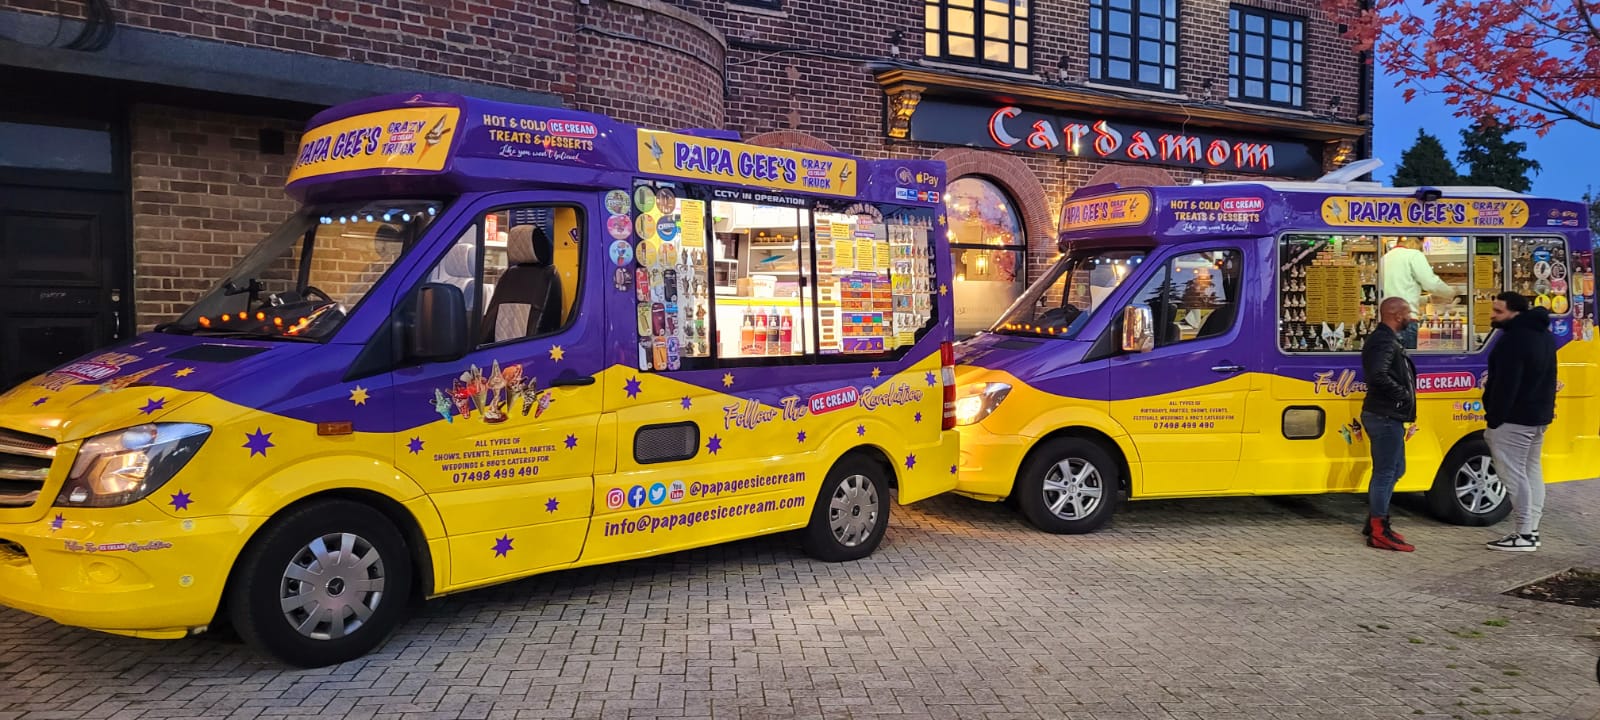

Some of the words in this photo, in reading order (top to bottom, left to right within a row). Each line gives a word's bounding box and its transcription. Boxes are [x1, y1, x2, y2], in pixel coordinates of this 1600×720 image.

[387, 121, 426, 134] CRAZY
[483, 114, 507, 128] HOT
[509, 117, 518, 129] &
[520, 118, 547, 132] COLD
[550, 122, 563, 133] ICE
[564, 123, 595, 135] CREAM
[489, 129, 532, 145] TREATS
[533, 134, 542, 146] &
[543, 135, 593, 151] DESSERTS
[987, 105, 1276, 172] Cardamom
[296, 135, 333, 169] PAPA
[331, 125, 384, 161] GEE'S
[382, 142, 416, 155] TRUCK
[674, 141, 735, 177] PAPA
[736, 152, 798, 184] GEE'S
[801, 158, 833, 171] CRAZY
[802, 176, 831, 189] TRUCK
[923, 172, 939, 188] Pay
[714, 189, 739, 199] CCTV
[742, 192, 752, 200] IN
[754, 193, 805, 206] OPERATION
[1170, 200, 1190, 209] HOT
[1190, 201, 1197, 210] &
[1199, 201, 1220, 211] COLD
[1223, 200, 1234, 209] ICE
[1235, 199, 1262, 209] CREAM
[1082, 201, 1109, 221] GEE'S
[1349, 201, 1404, 224] PAPA
[1407, 201, 1467, 225] GEE'S
[1472, 202, 1508, 210] CRAZY
[1175, 211, 1208, 221] TREATS
[1209, 212, 1216, 221] &
[1217, 212, 1260, 223] DESSERTS
[1472, 216, 1505, 226] TRUCK
[1416, 377, 1431, 390] ICE
[1433, 375, 1473, 389] CREAM
[723, 397, 778, 431] Follow
[780, 394, 808, 421] The
[811, 397, 825, 411] ICE
[826, 391, 857, 409] CREAM
[858, 382, 924, 411] Revolution
[1153, 422, 1180, 430] 07498
[1182, 421, 1197, 429] 499
[1199, 421, 1215, 429] 490
[475, 440, 487, 448] ALL
[490, 438, 511, 446] TYPES
[513, 437, 521, 445] OF
[442, 461, 478, 471] WEDDINGS
[507, 457, 536, 466] CATERED
[537, 455, 549, 463] FOR
[453, 470, 491, 484] 07498
[494, 468, 515, 479] 499
[518, 465, 539, 477] 490
[689, 471, 806, 498] @papageesicecream
[671, 490, 684, 500] Tube
[604, 495, 806, 537] info@papageesicecream.com
